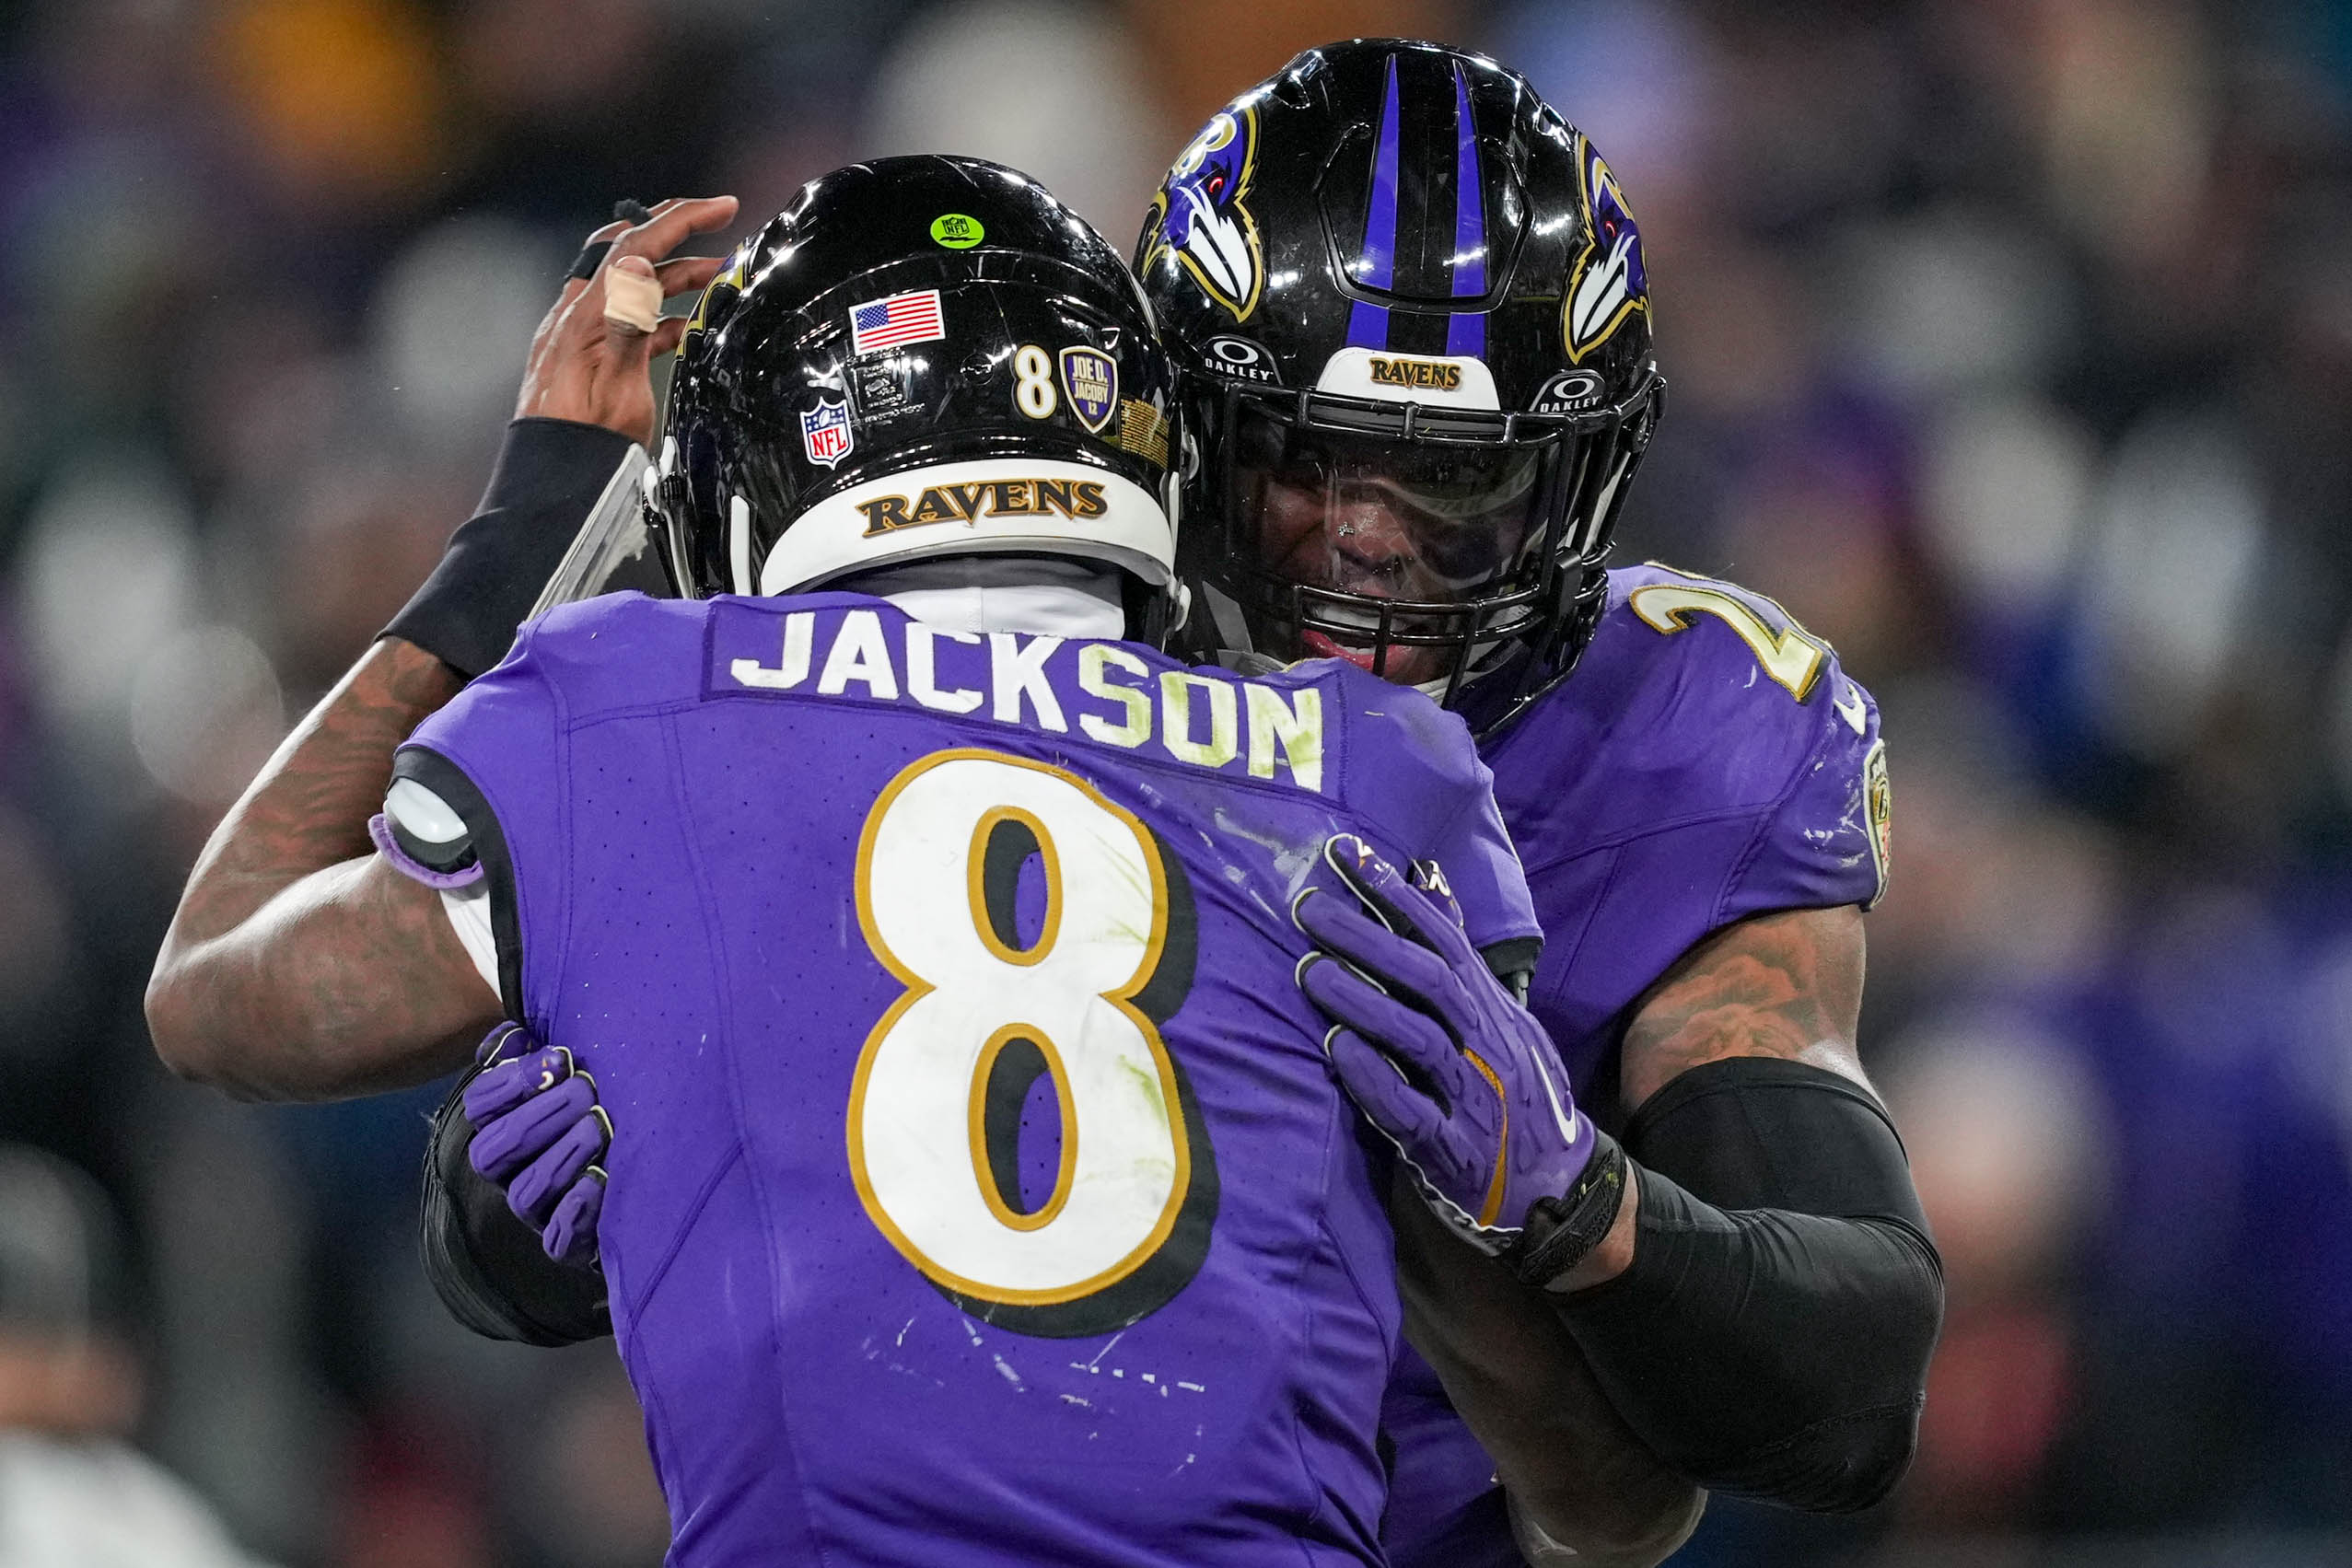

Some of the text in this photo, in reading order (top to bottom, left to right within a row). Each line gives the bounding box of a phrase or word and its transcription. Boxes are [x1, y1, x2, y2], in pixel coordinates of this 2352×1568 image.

[1015, 344, 1058, 419] 8
[1073, 355, 1108, 383] JOE D.
[1205, 358, 1271, 380] OAKLEY
[1369, 357, 1461, 390] RAVENS
[1074, 381, 1109, 404] JACOBY
[1540, 396, 1600, 412] OAKLEY
[811, 427, 847, 457] NFL
[856, 478, 1109, 538] RAVENS
[730, 610, 1322, 793] JACKSON
[845, 747, 1212, 1331] 8
